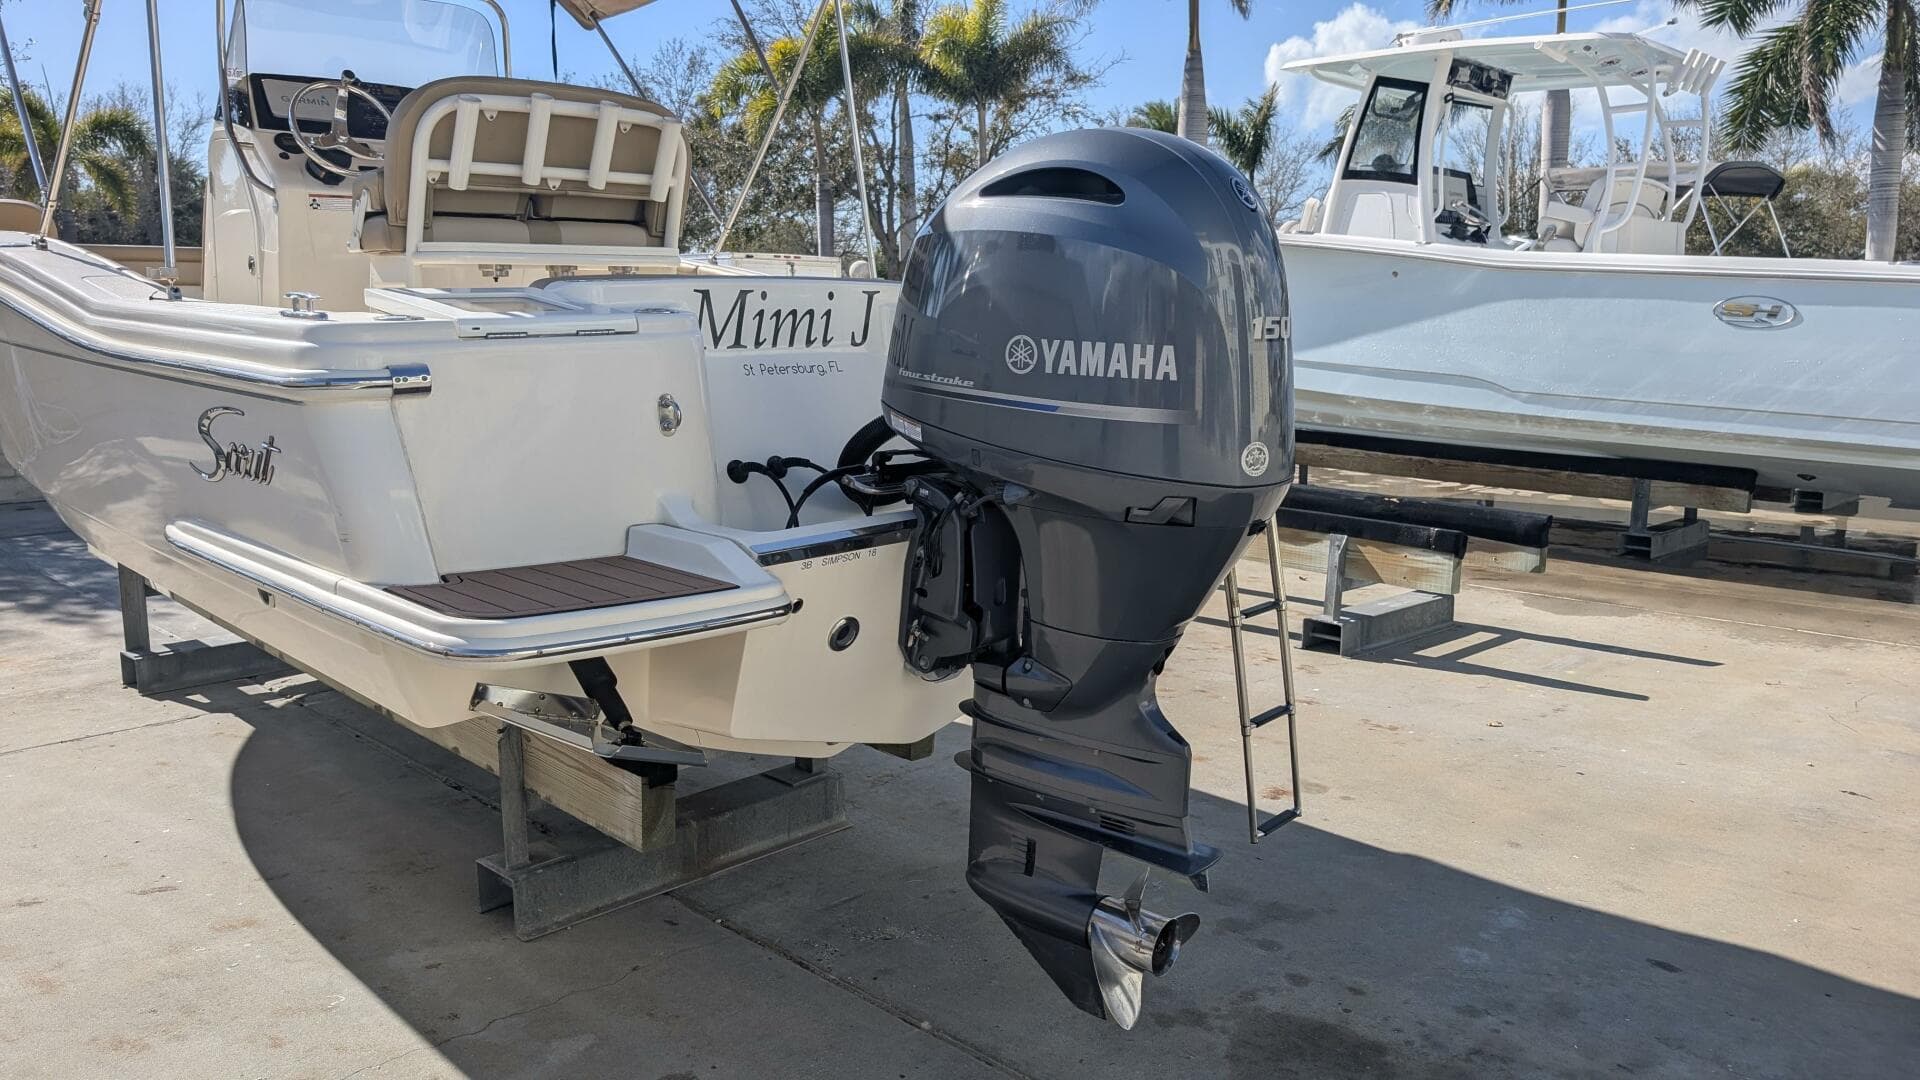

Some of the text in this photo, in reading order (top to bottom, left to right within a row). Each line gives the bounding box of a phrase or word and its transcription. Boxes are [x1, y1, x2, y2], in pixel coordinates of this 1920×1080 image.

[281, 95, 330, 106] GRMIN
[693, 288, 881, 350] Mimi J
[1252, 316, 1291, 340] 150
[1041, 338, 1178, 381] YAMAHA
[743, 364, 756, 376] St
[821, 551, 861, 567] SIMPSON
